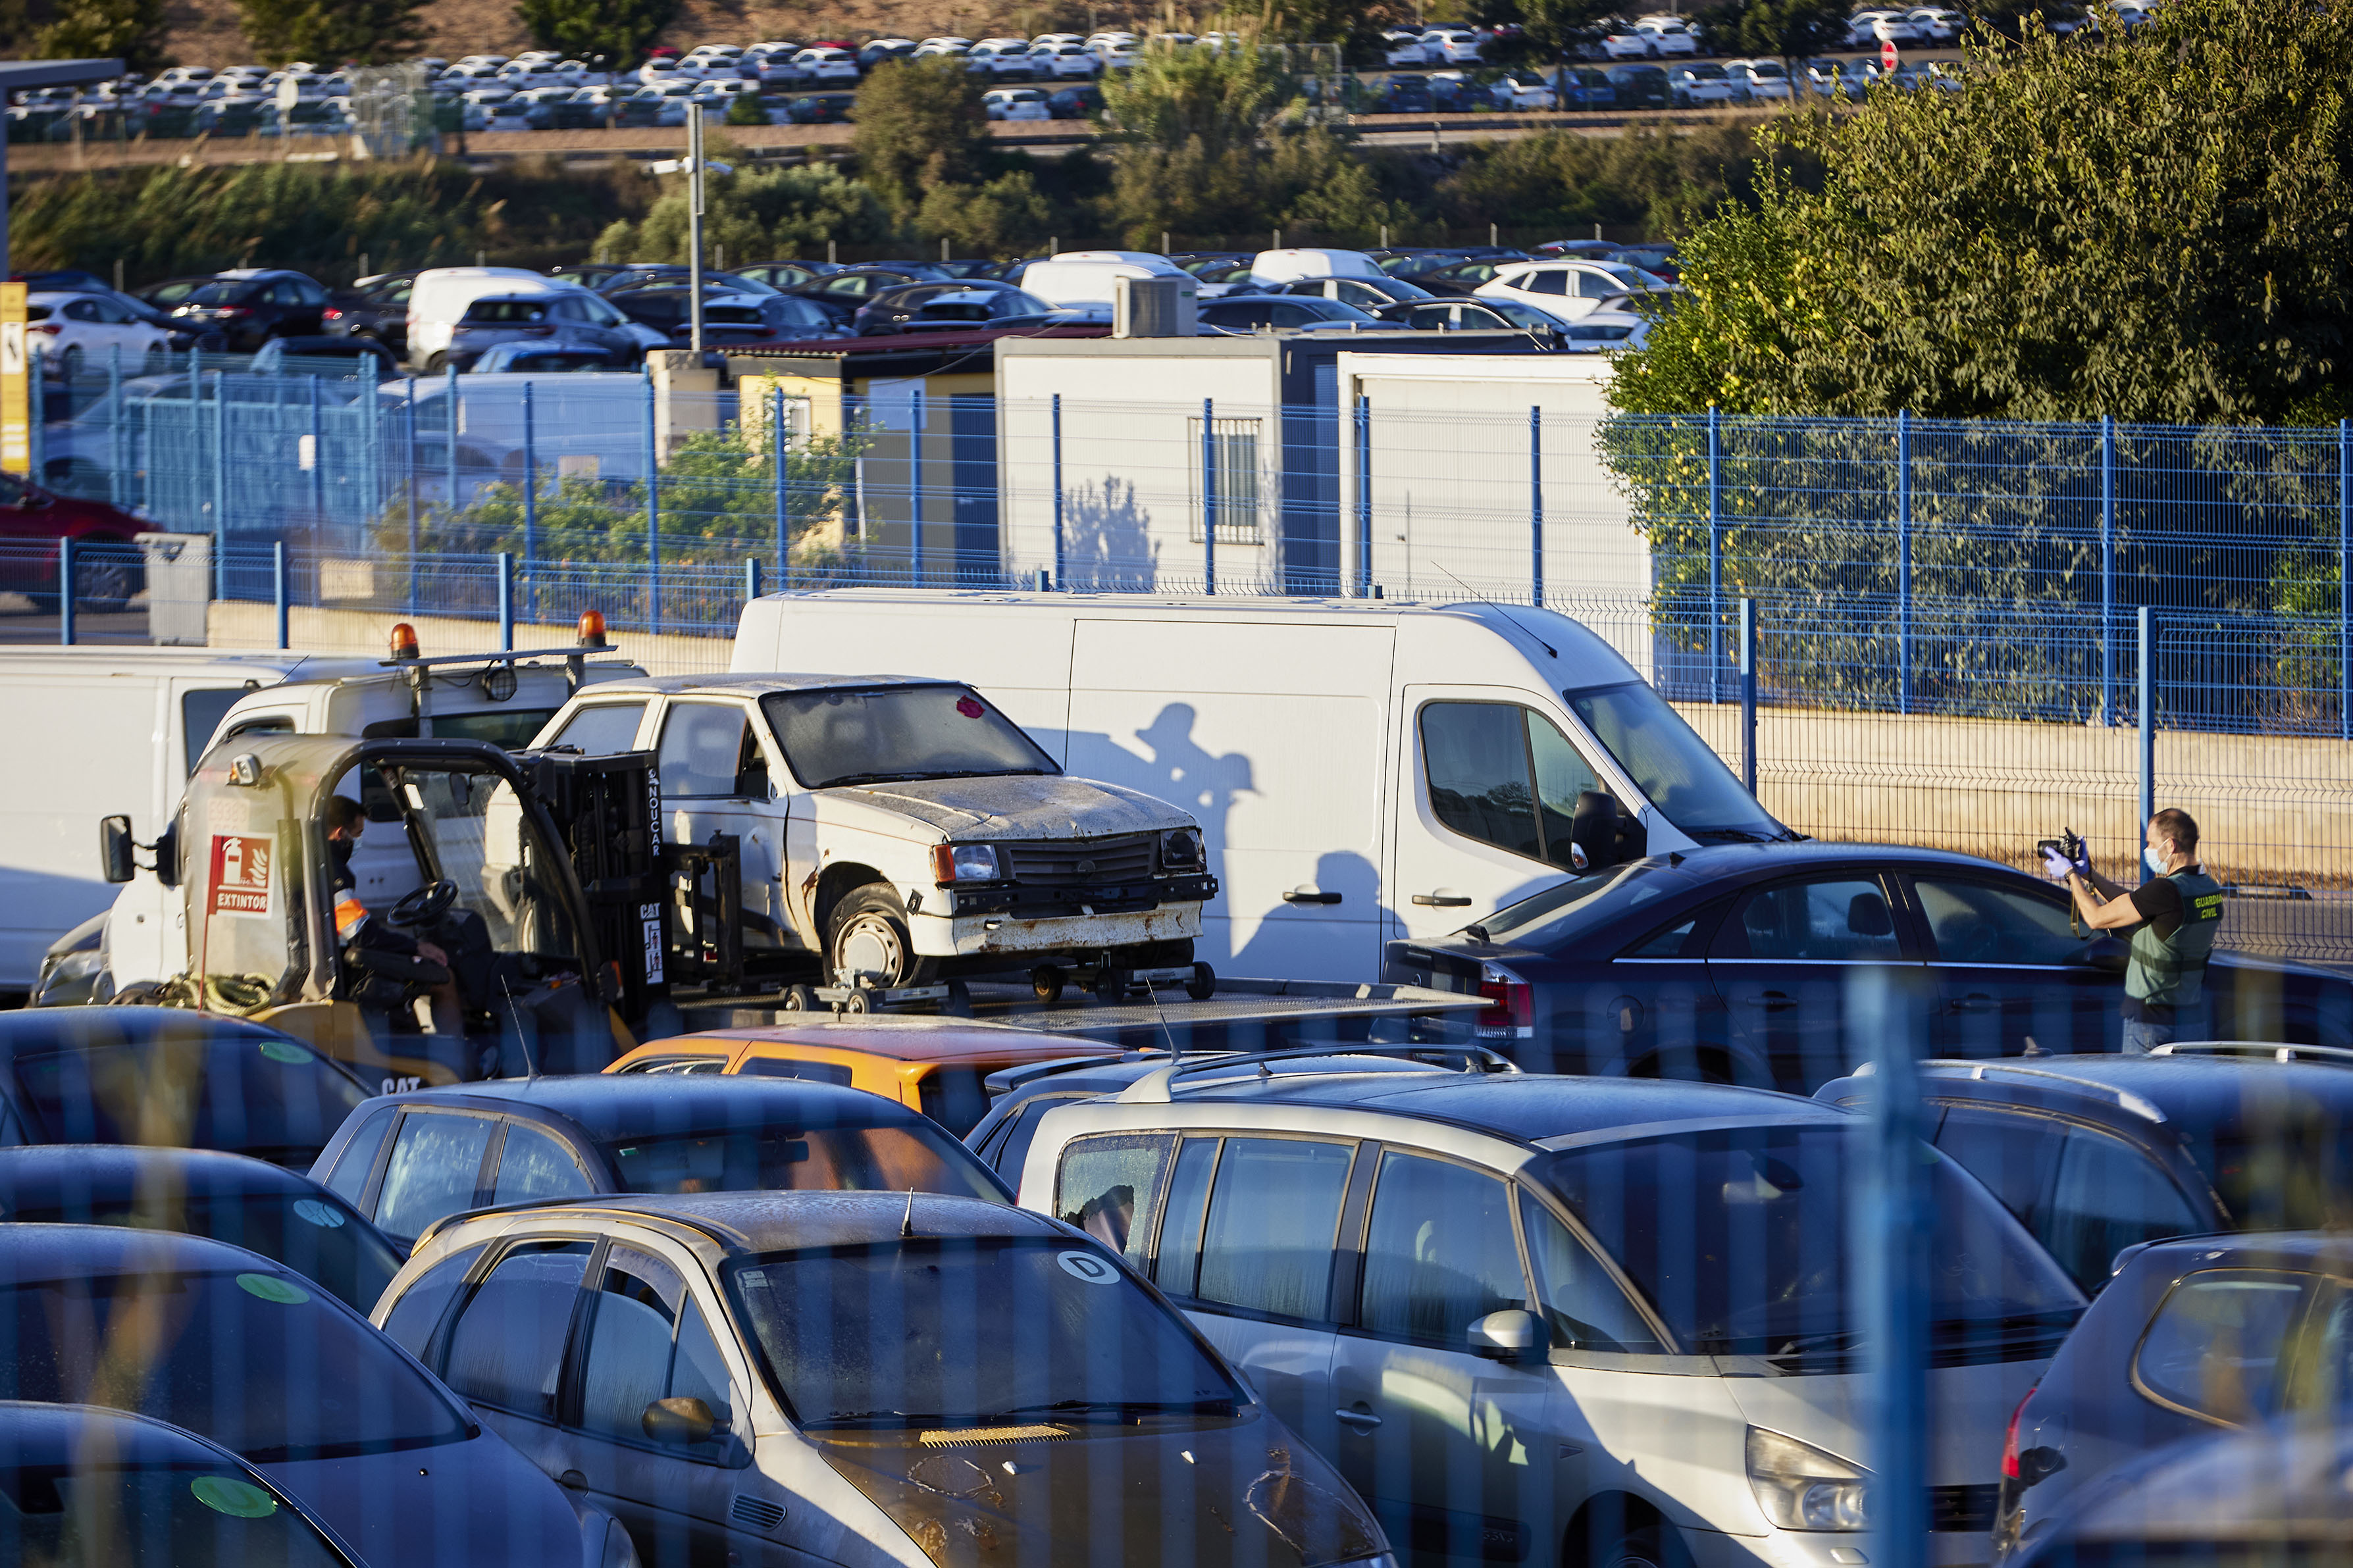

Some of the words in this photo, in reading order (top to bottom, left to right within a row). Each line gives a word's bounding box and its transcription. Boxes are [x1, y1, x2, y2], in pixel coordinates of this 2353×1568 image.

[218, 893, 267, 910] EXTINTOR
[2195, 894, 2222, 907] GUARDIA
[640, 902, 661, 919] CAT
[2202, 907, 2217, 919] CIVIL
[382, 1076, 421, 1095] CAT
[1066, 1257, 1106, 1278] D
